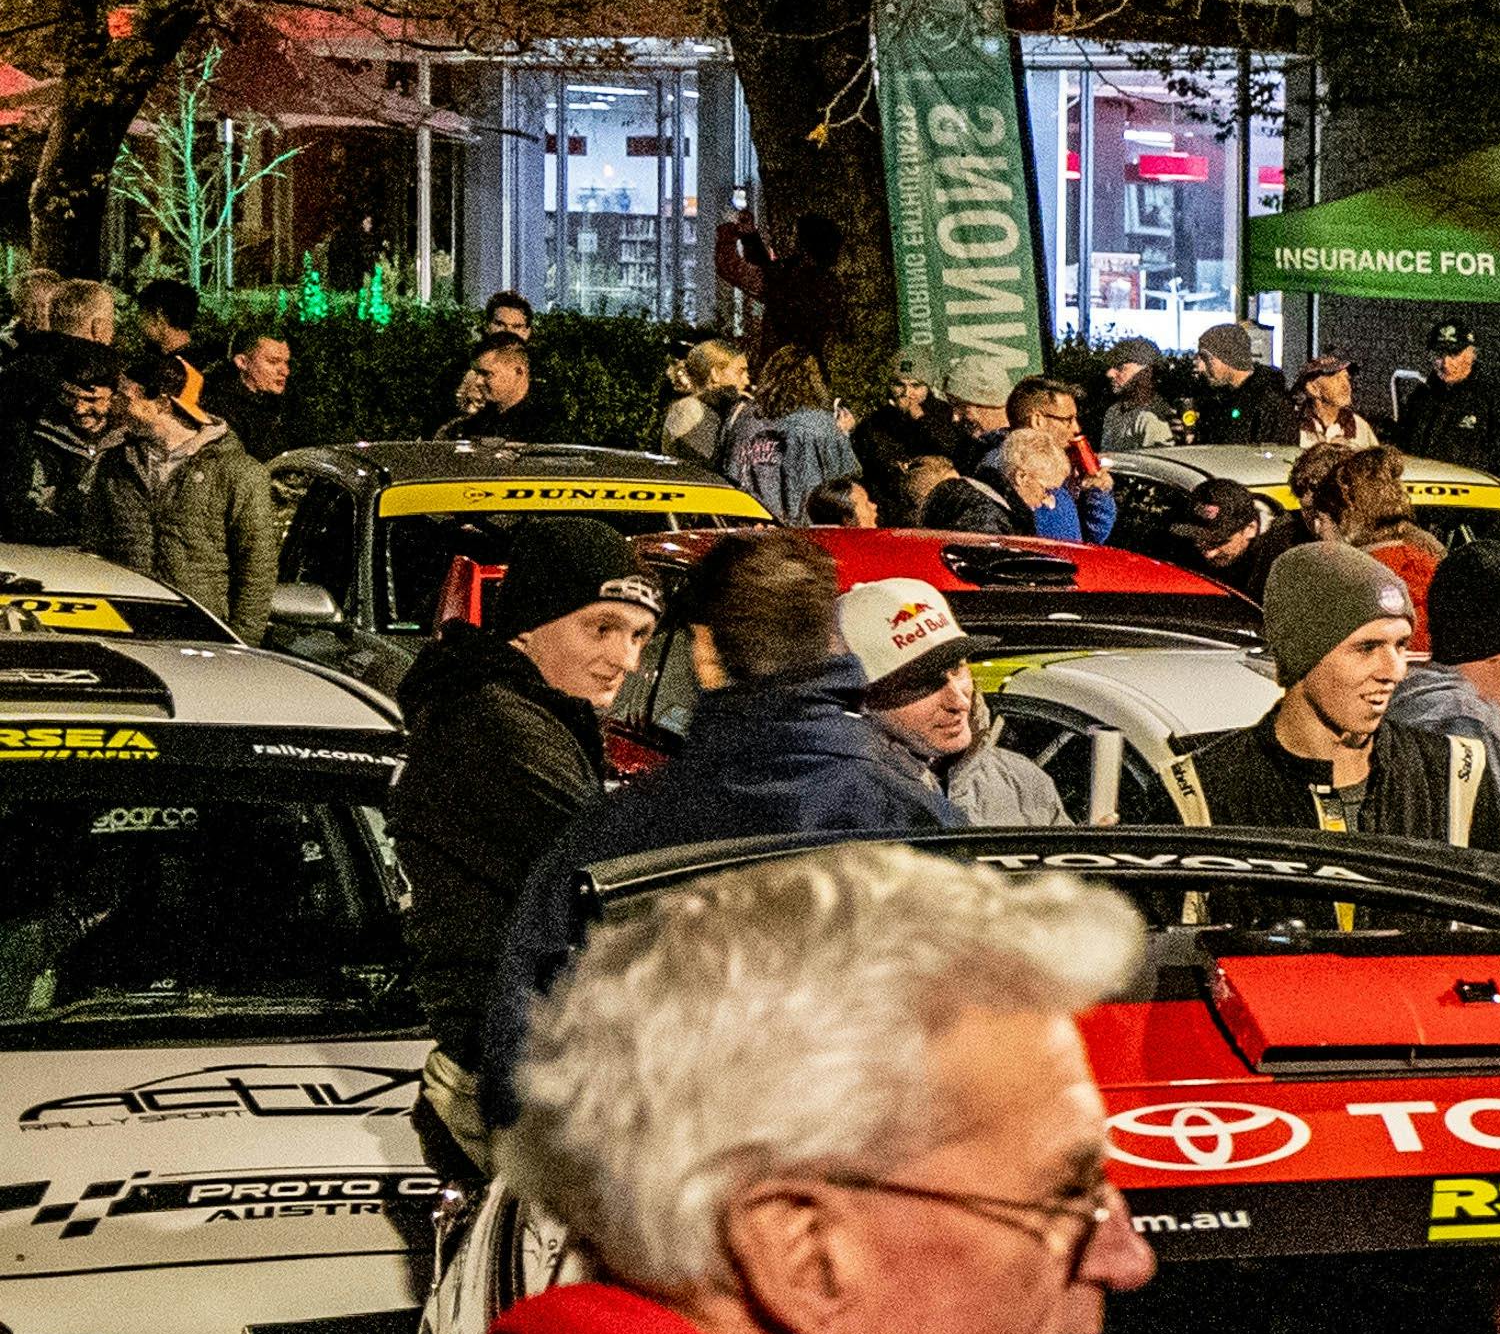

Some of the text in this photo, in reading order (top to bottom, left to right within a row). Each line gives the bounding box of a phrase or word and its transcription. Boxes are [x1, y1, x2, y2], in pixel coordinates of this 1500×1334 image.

[1274, 246, 1433, 274] INSURANCE
[1440, 251, 1496, 276] FOR
[501, 487, 687, 503] DUNLOP
[892, 612, 950, 650] Red Bull
[0, 728, 157, 749] RSEA
[976, 853, 1385, 884] TOYOTA
[20, 1109, 244, 1134] RALLY SPORT
[188, 1177, 444, 1205] PROTO C
